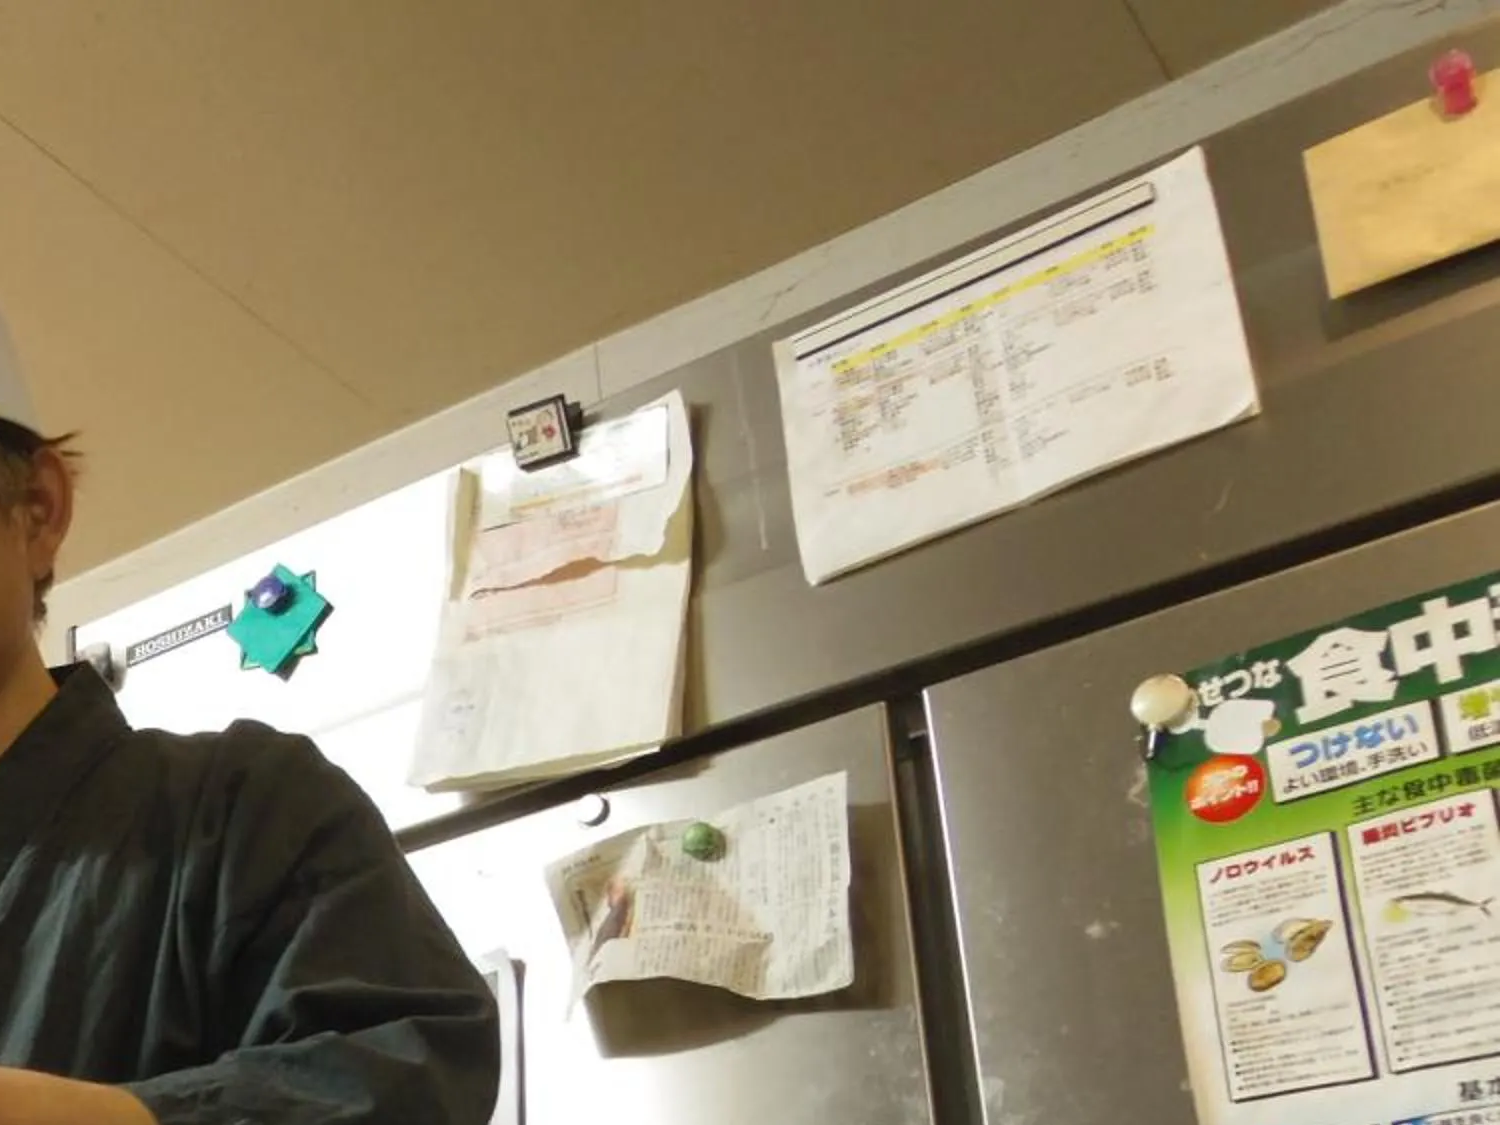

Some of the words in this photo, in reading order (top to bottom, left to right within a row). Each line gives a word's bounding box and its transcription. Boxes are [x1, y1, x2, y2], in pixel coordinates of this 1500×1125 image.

[134, 610, 224, 660] HOSHIZAKI
[1287, 582, 1500, 725] 食中
[1289, 714, 1420, 769] つけない
[1209, 846, 1317, 884] ノロウイルス
